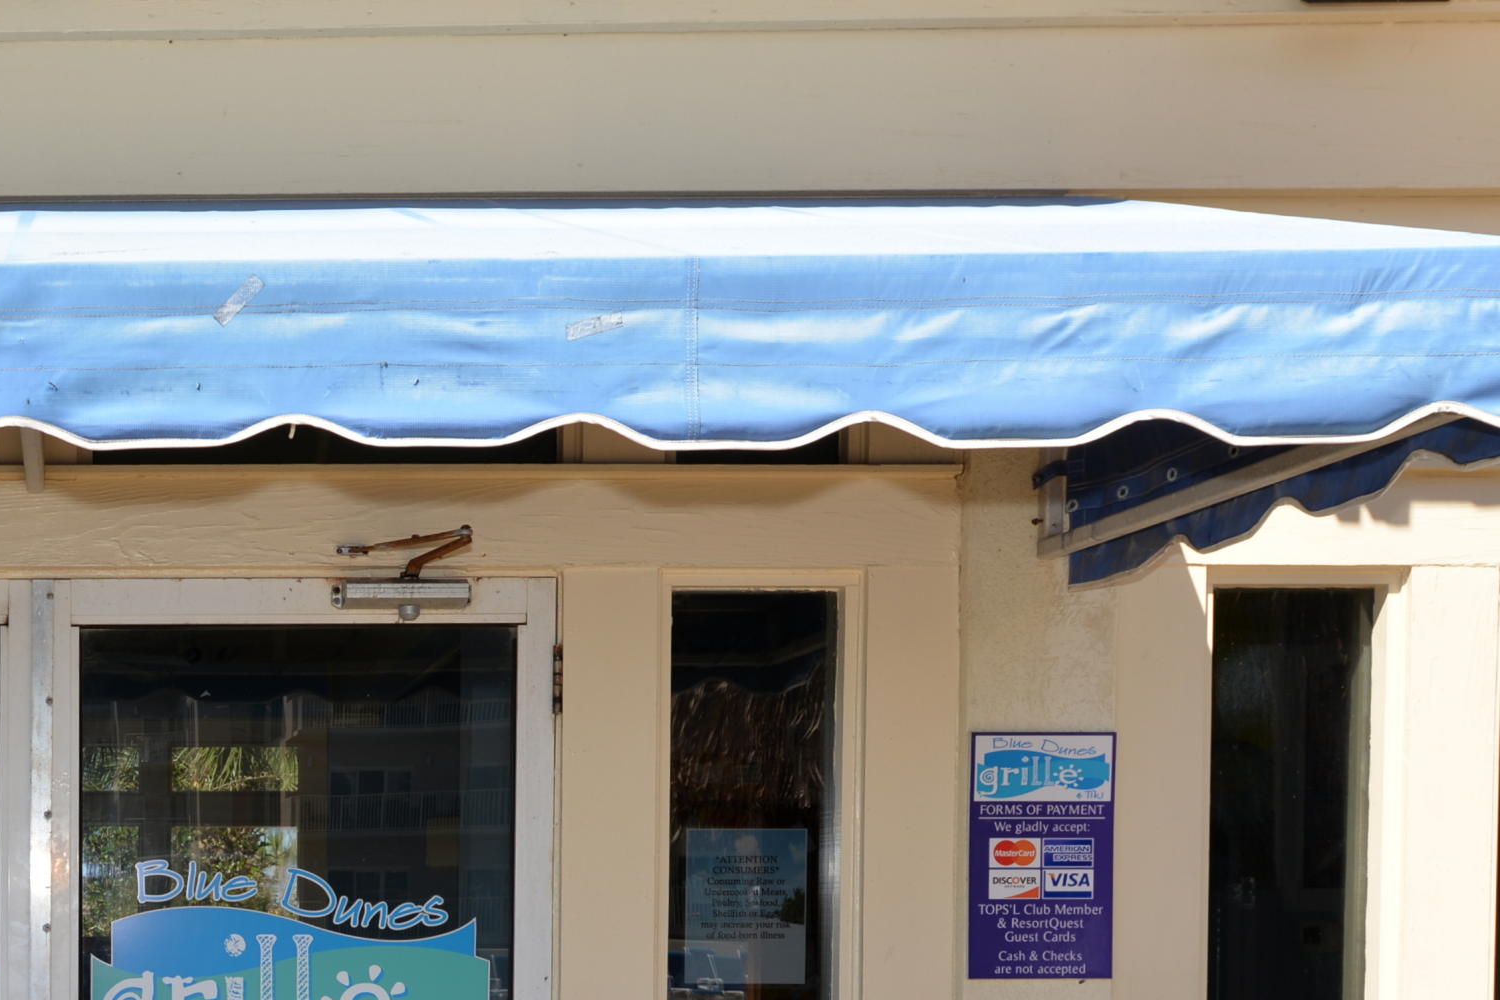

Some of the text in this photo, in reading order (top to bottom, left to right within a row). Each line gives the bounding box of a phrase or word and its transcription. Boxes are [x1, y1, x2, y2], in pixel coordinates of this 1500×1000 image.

[992, 737, 1097, 755] Blue Dunes
[979, 756, 1084, 797] grille
[980, 804, 1104, 815] FORMS OF PAYMENT
[994, 821, 1090, 834] We gladly accept:
[995, 849, 1035, 857] MasterCard
[1044, 845, 1091, 853] AMERICAN
[1049, 873, 1089, 886] VISA
[135, 859, 449, 930] Blue Dunes
[978, 904, 1103, 915] TOPS'L Club Member
[997, 918, 1084, 930] & ResortQuest
[1005, 931, 1076, 942] Guest Cards
[998, 951, 1082, 961] Cash & Checks
[994, 963, 1086, 976] are not accepted
